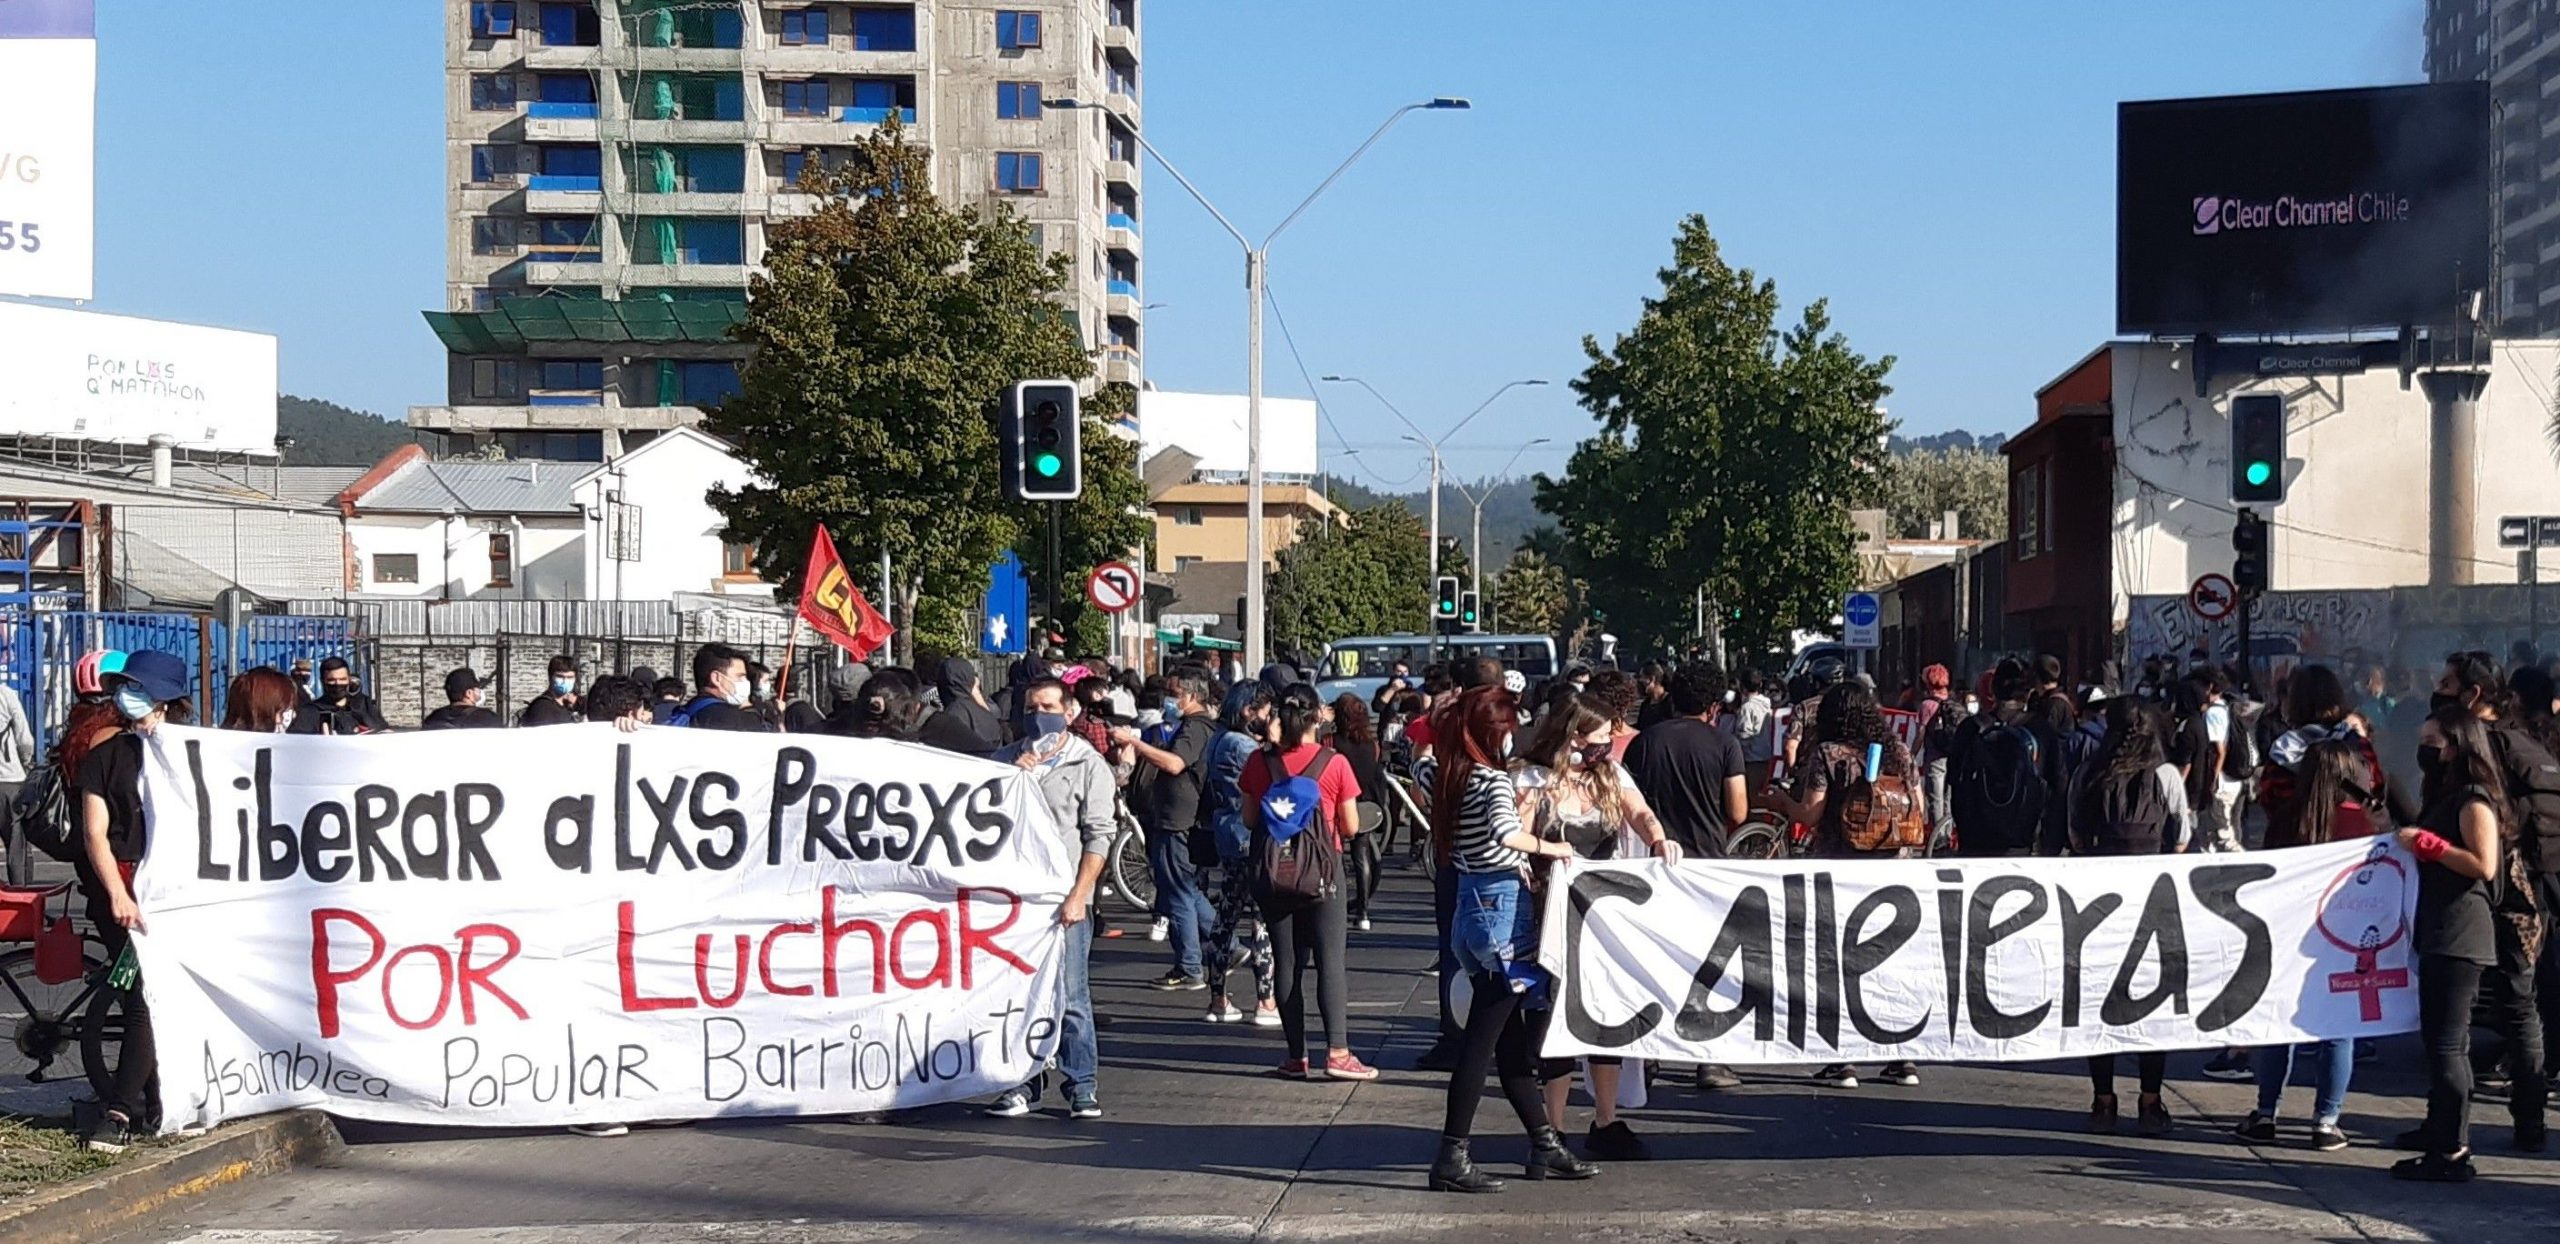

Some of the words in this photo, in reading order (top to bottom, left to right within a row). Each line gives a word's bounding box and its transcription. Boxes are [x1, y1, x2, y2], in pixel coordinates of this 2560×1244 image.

[2222, 199, 2272, 230] Clear
[2275, 194, 2353, 228] Channel
[2358, 192, 2409, 223] Chile
[543, 793, 596, 875] a
[196, 1038, 390, 1114] Asamblea
